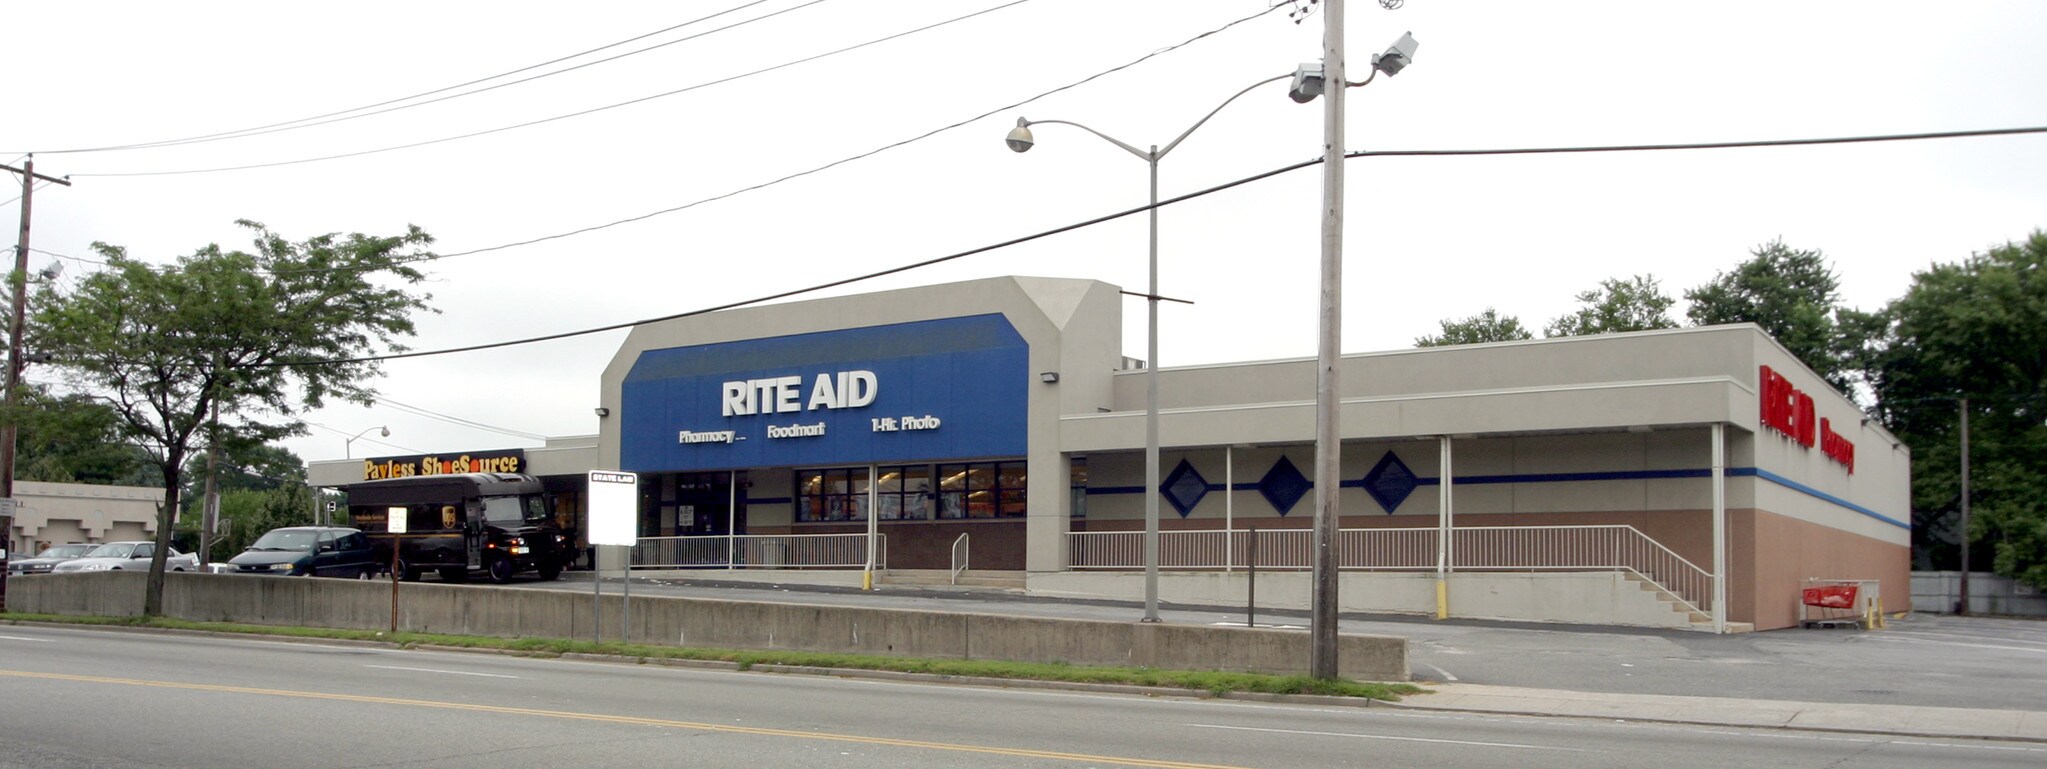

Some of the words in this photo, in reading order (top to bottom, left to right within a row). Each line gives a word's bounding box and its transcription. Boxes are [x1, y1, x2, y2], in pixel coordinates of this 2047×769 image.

[722, 376, 801, 417] RITE
[807, 370, 878, 411] AID
[767, 421, 826, 439] Foodmart
[901, 414, 941, 431] Photo
[679, 430, 736, 444] Pharmacy
[364, 459, 416, 481] Payless
[421, 455, 518, 476] ShoeSource
